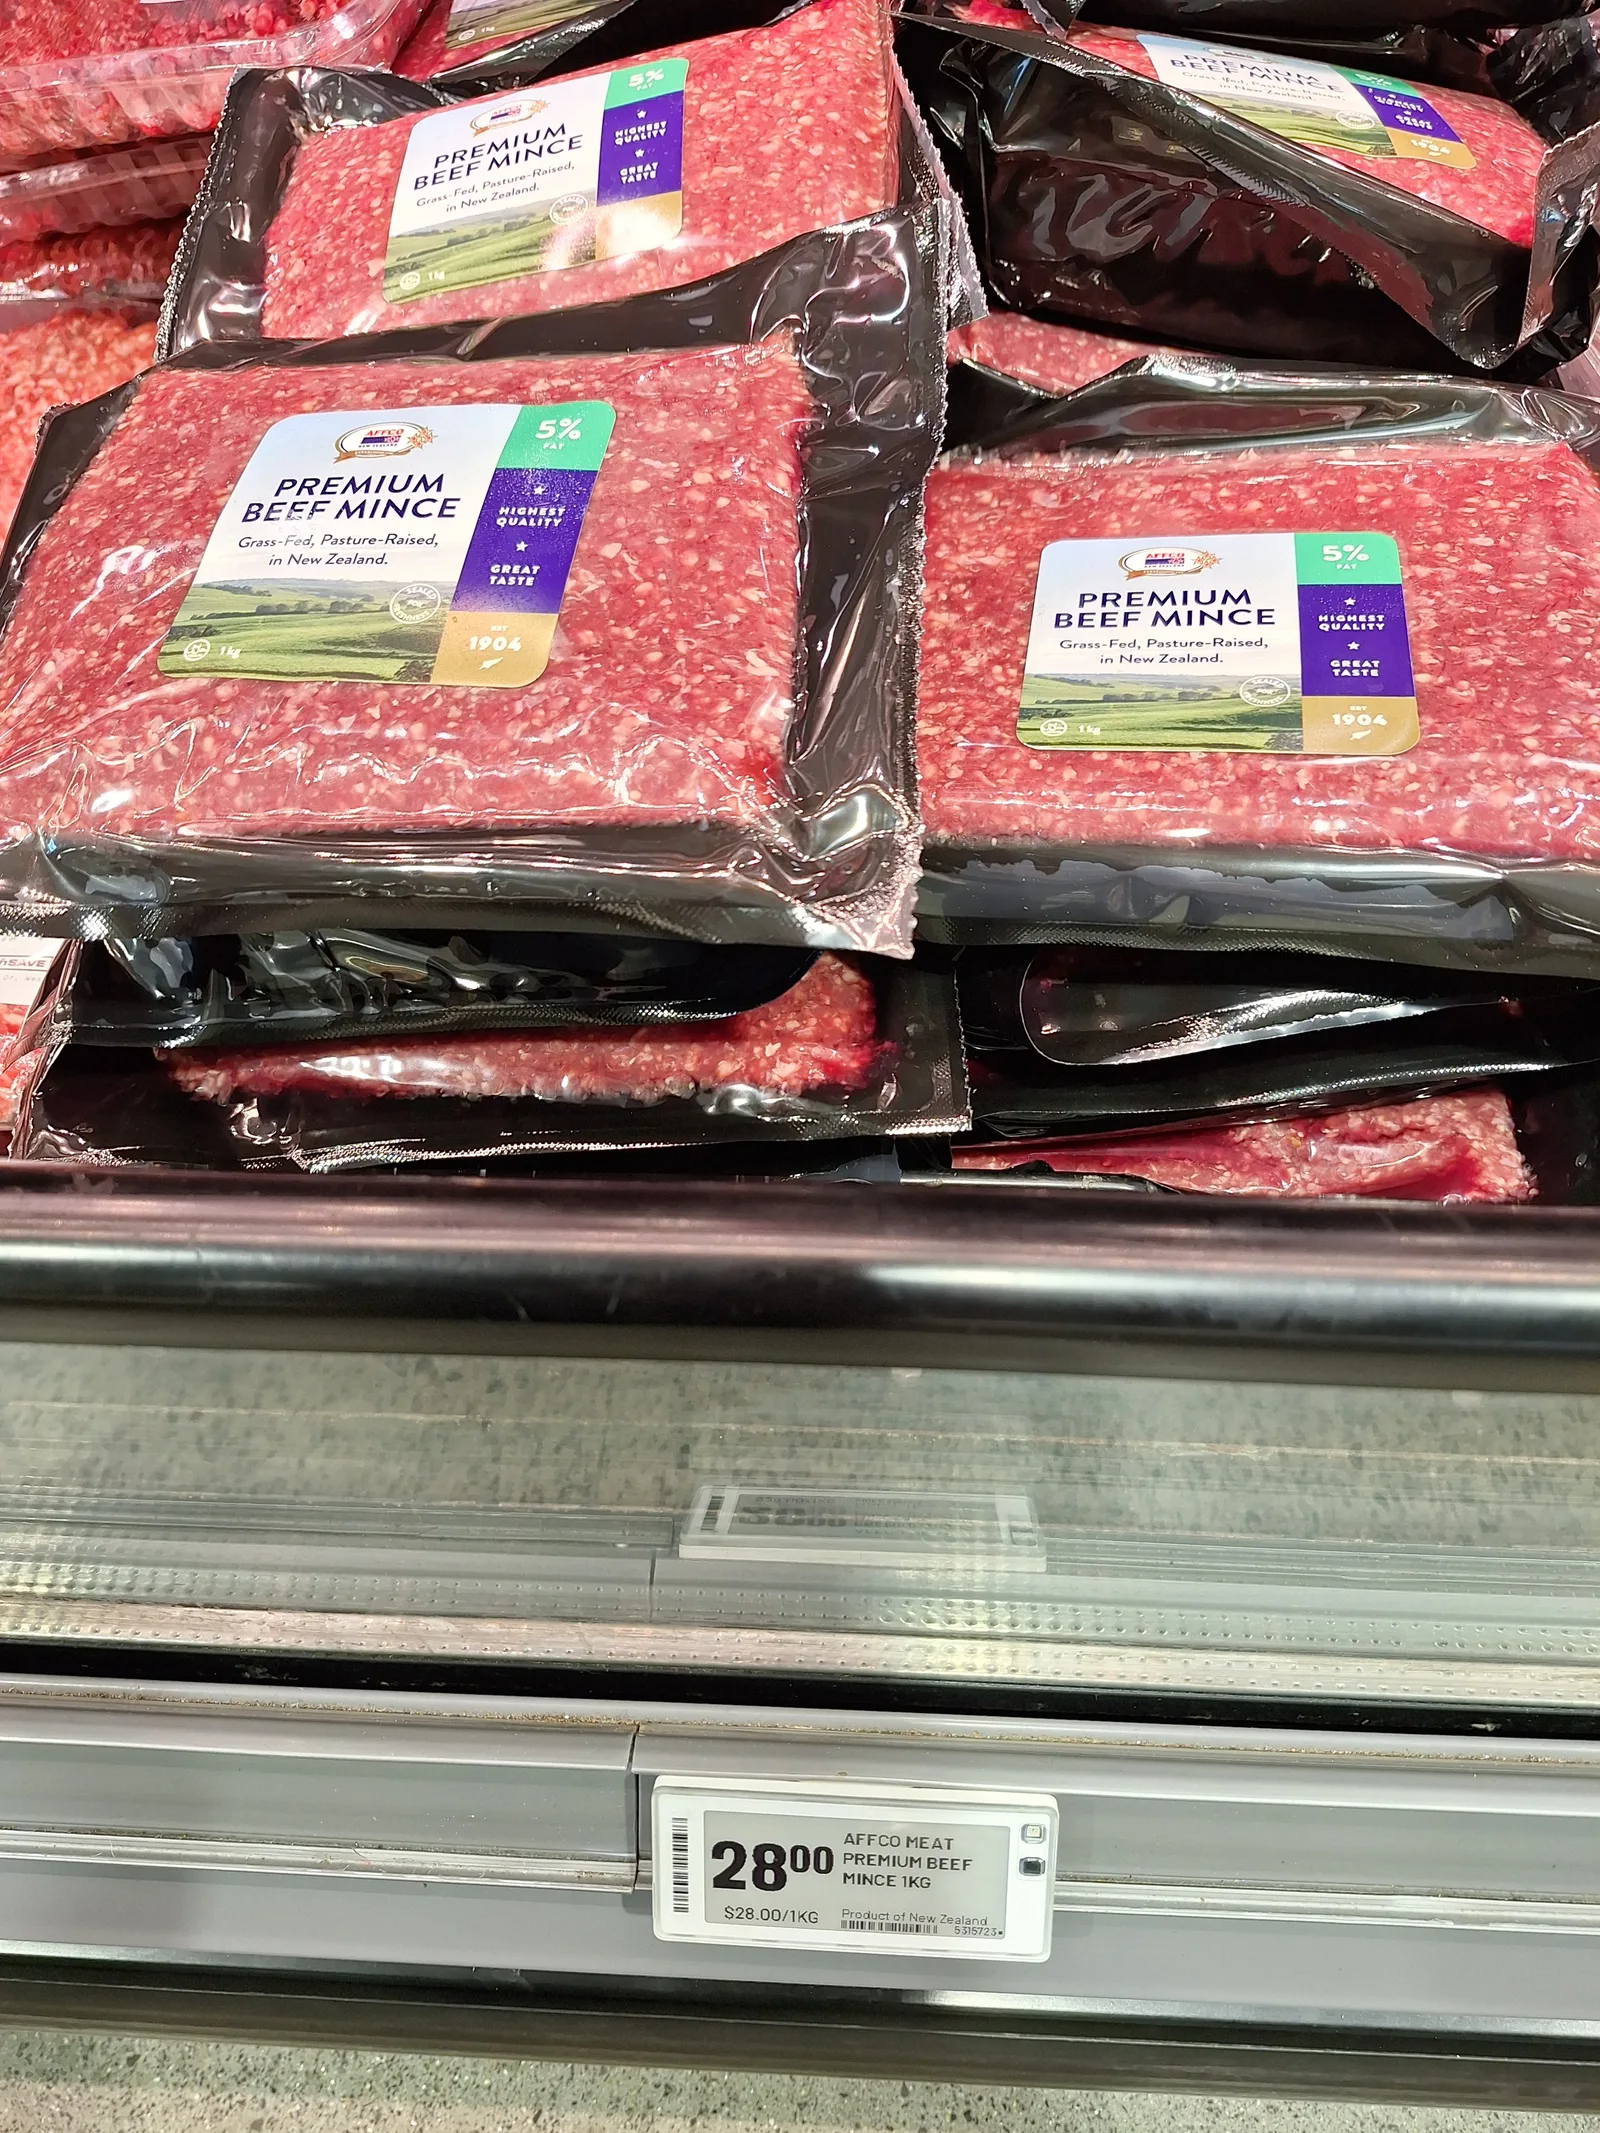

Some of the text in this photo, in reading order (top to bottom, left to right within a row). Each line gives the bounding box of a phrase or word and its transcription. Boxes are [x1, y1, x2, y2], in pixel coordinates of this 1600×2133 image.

[1171, 59, 1239, 74] BEEF
[1249, 71, 1344, 93] MINCE
[1183, 54, 1319, 82] PREMIUM
[628, 68, 664, 87] 5%
[434, 123, 567, 169] PREMIUM
[413, 134, 583, 191] BEEF MINCE
[416, 161, 576, 207] Grass-Fed, Pasture-Raised,
[445, 183, 540, 213] in New Zealand.
[365, 428, 405, 437] AFFCO
[535, 418, 582, 440] 5%
[542, 442, 565, 450] FAT
[274, 473, 444, 497] PREMIUM
[241, 497, 461, 523] BEEF MINCE
[498, 506, 566, 516] HIGHEST
[496, 517, 563, 527] QUALITY
[238, 533, 439, 549] Grass-Fed, Pasture-Raised,
[268, 552, 389, 566] in New Zealand.
[1322, 544, 1370, 562] 5%
[490, 564, 541, 575] GREAT
[489, 576, 535, 587] TASTE
[1078, 588, 1251, 608] PREMIUM
[1054, 608, 1276, 629] BEEF MINCE
[1318, 614, 1385, 622] HIGHEST
[1318, 622, 1385, 632] QUALITY
[469, 636, 522, 652] 1904
[1059, 637, 1269, 650] Grass-Fed, Pasture-Raised,
[1099, 652, 1224, 664] in New Zealand.
[1330, 660, 1381, 668] GREAT
[1332, 669, 1380, 677] TASTE
[1331, 713, 1388, 727] 1904
[843, 1833, 954, 1850] AFFCO MEAT
[843, 1852, 973, 1871] PREMIUM BEEF
[843, 1872, 931, 1888] MINCE 1KG
[724, 1905, 819, 1924] $28.00/1KG
[841, 1909, 988, 1926] Product of New Zealand
[954, 1926, 997, 1936] 5315723
